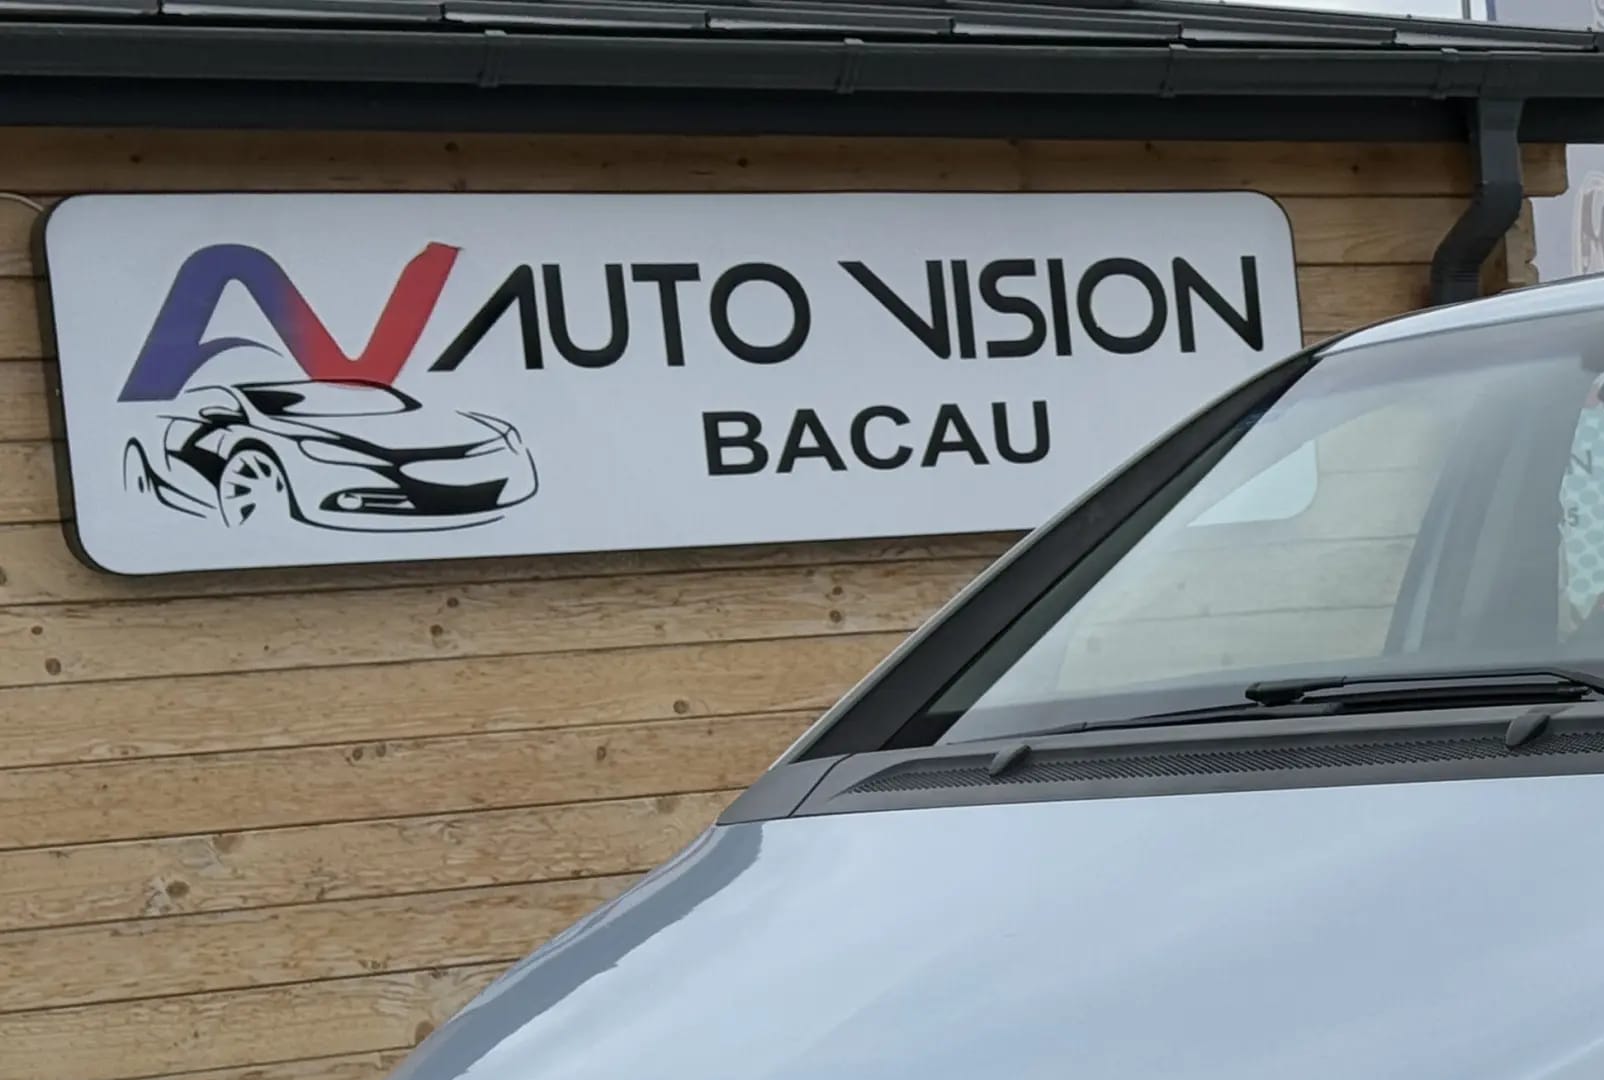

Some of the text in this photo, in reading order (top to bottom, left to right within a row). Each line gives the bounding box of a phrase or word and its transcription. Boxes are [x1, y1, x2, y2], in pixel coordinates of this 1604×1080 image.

[429, 256, 1264, 372] AUTO VISION
[702, 401, 1051, 477] BACAU
